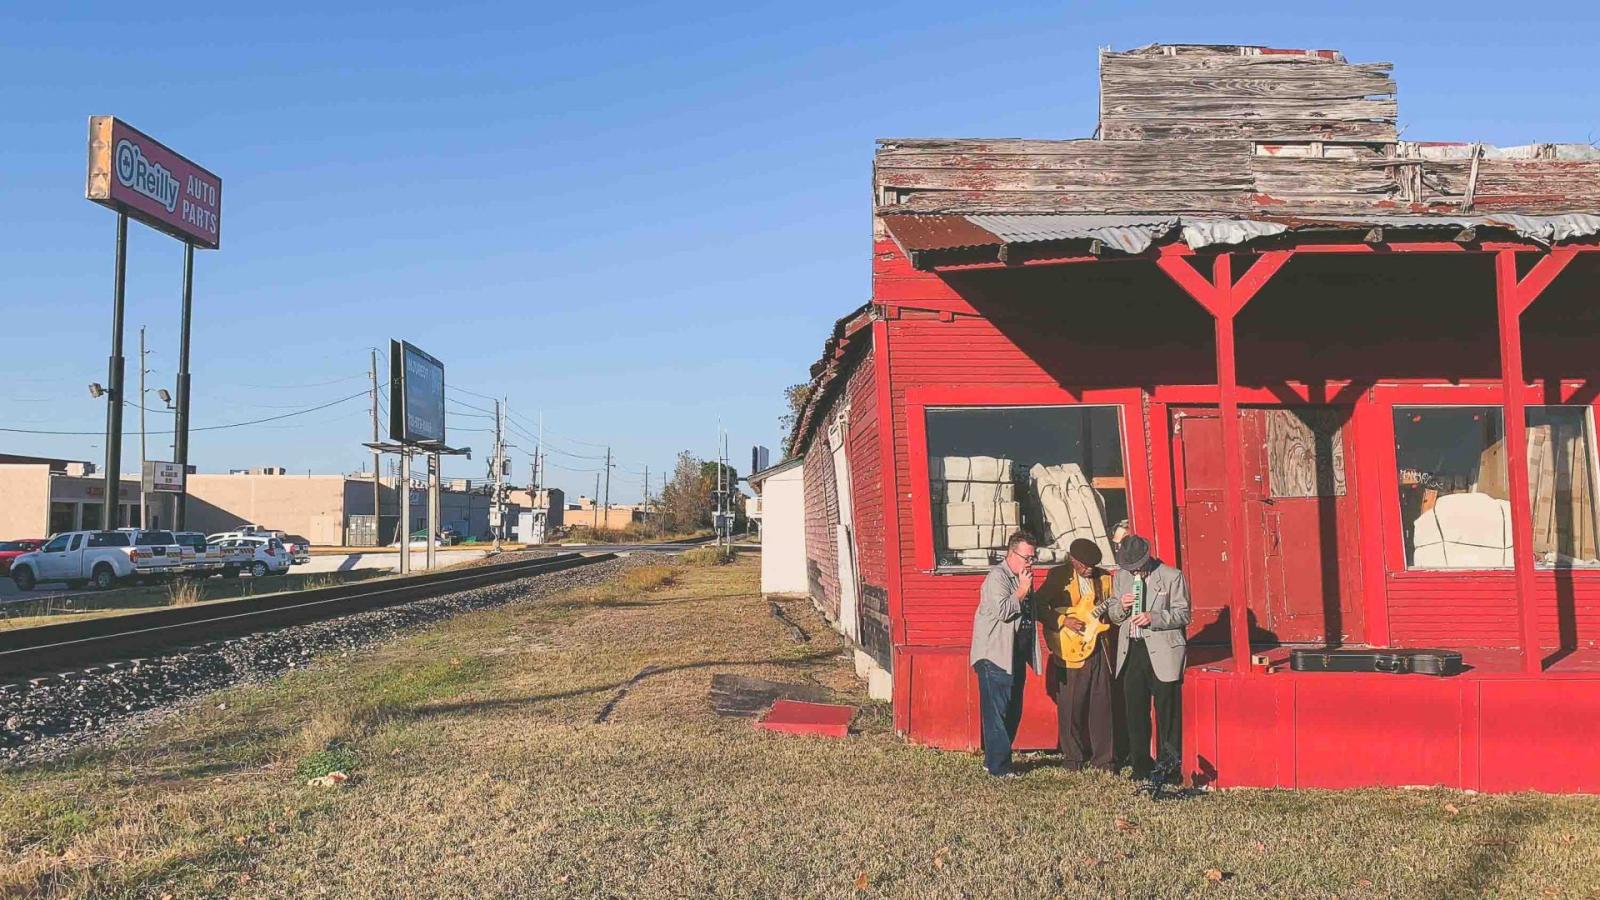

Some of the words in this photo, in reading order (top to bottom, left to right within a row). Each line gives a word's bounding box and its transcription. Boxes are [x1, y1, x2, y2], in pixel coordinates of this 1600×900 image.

[116, 141, 180, 211] O'Reilly
[187, 175, 215, 207] AUTO
[182, 199, 217, 234] PARTS
